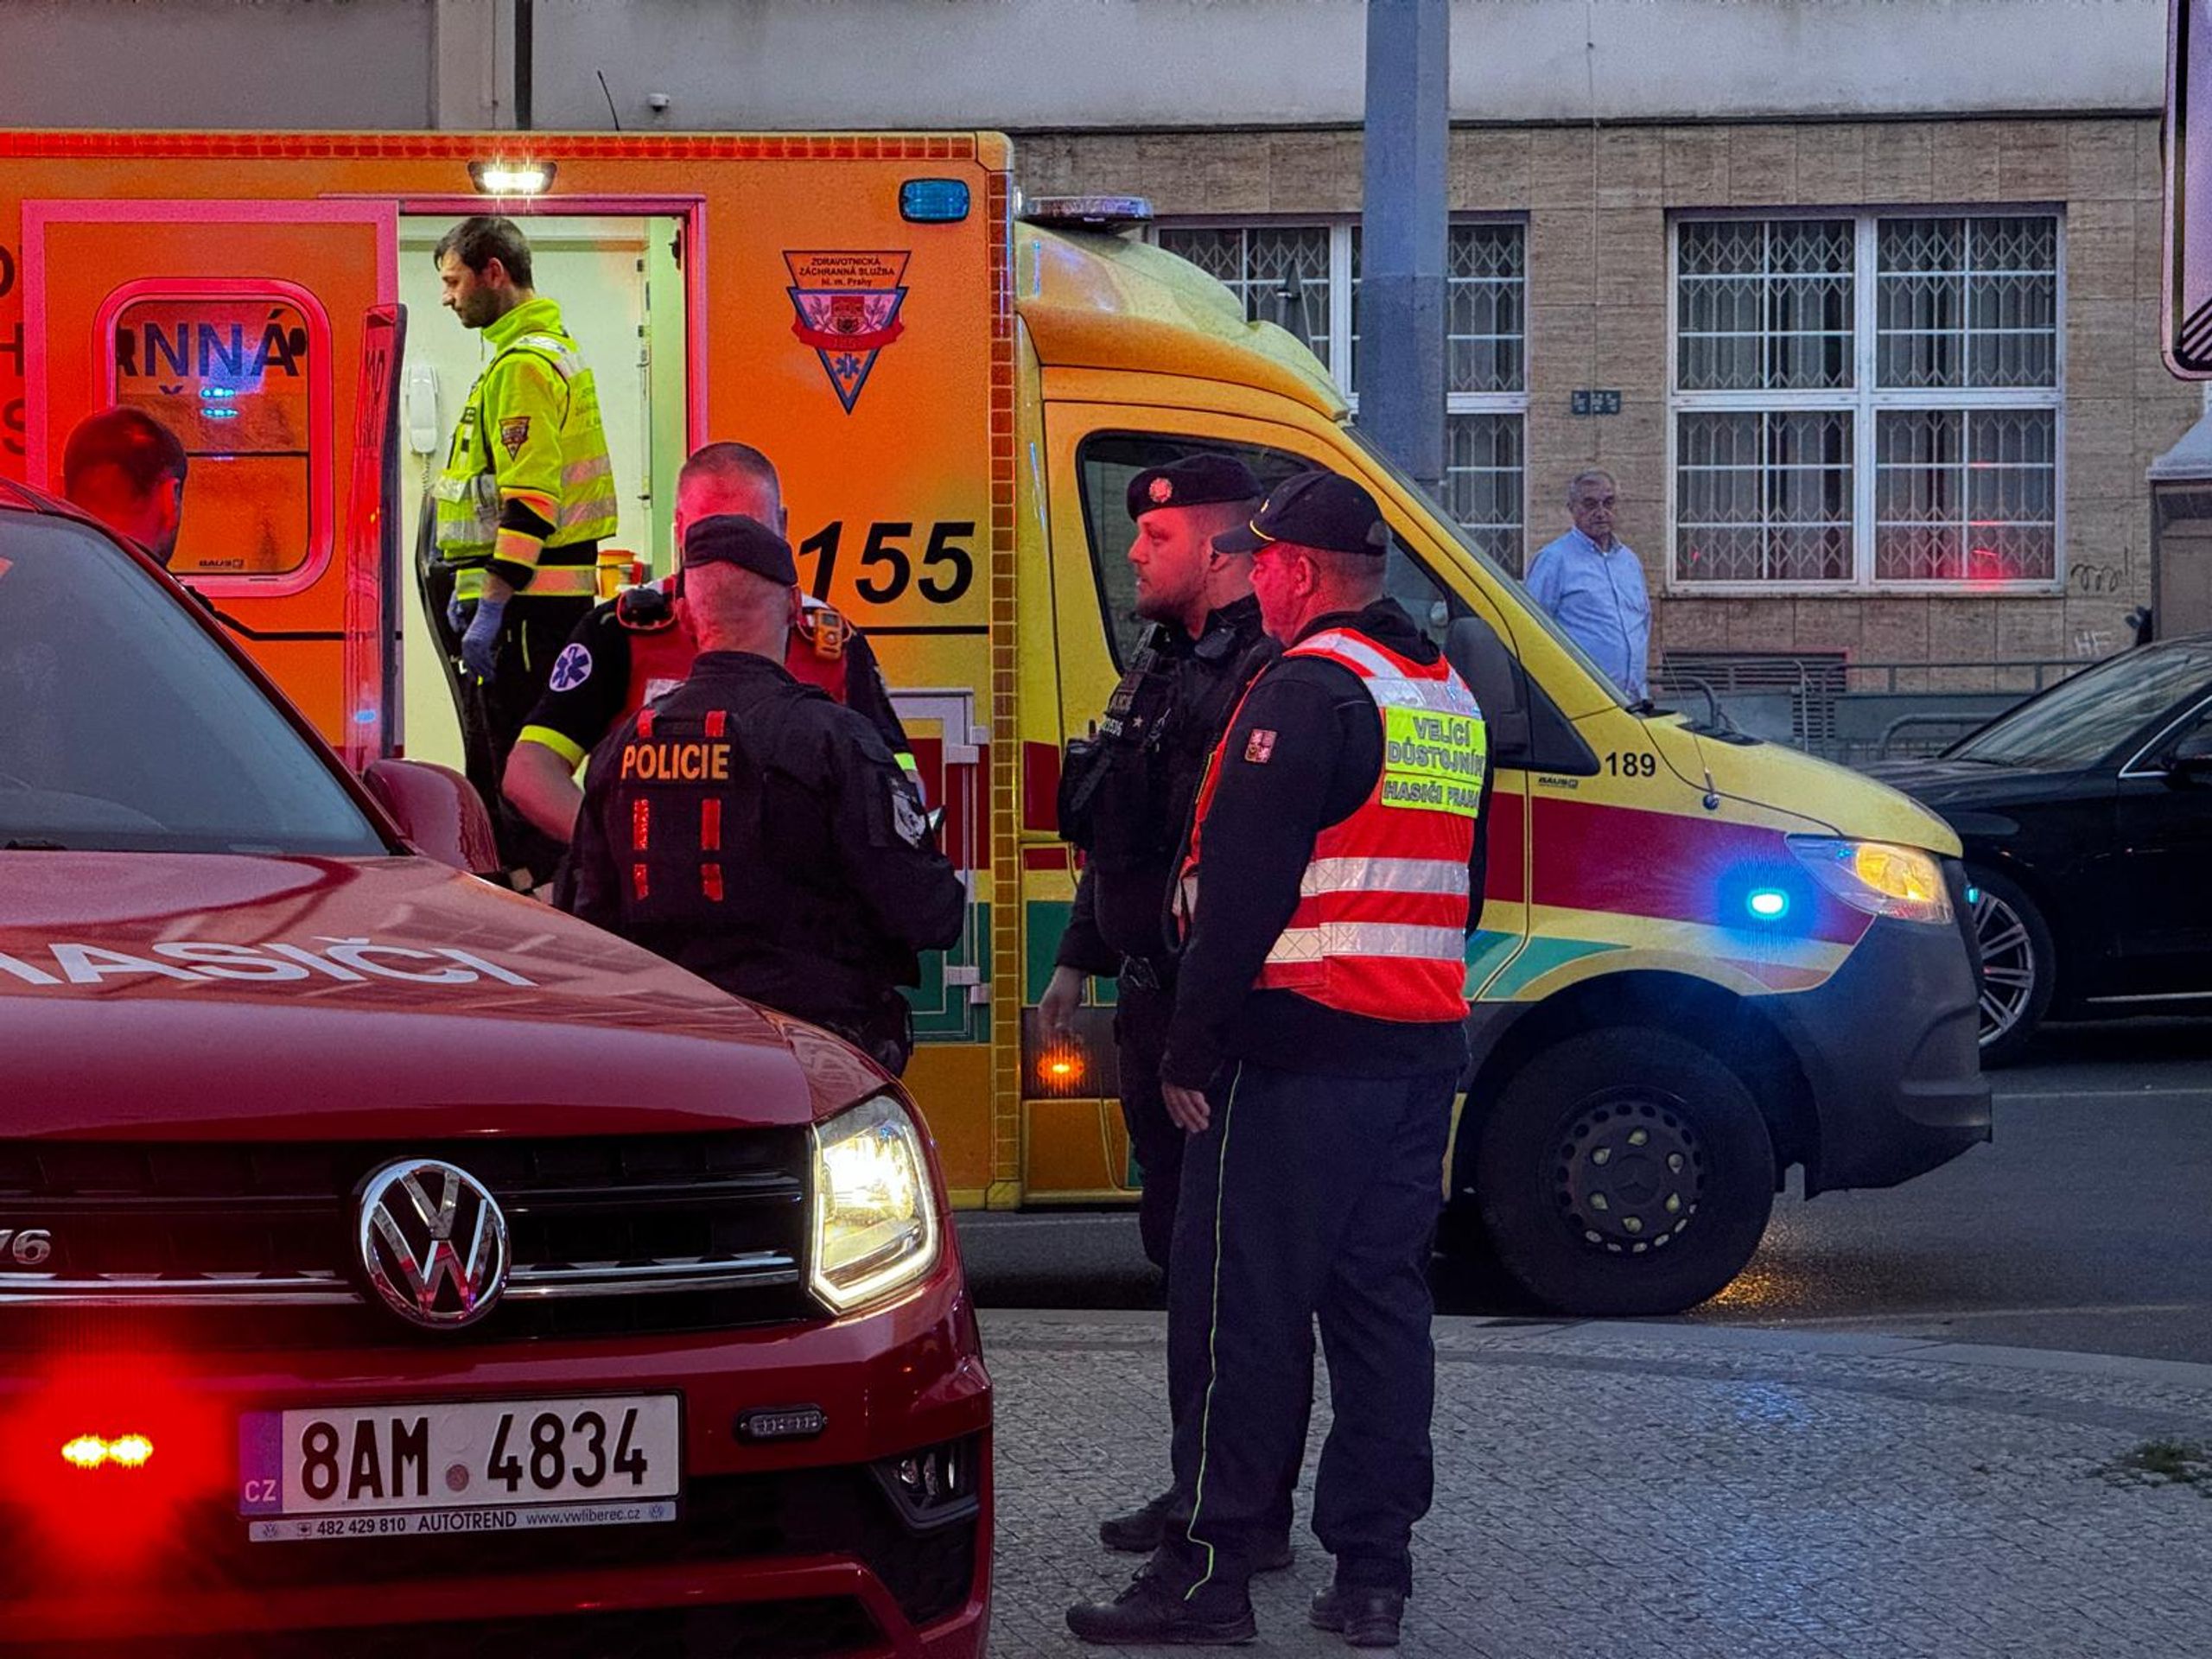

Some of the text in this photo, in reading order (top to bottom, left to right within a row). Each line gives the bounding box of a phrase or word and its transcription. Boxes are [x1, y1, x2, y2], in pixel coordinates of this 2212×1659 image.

[799, 521, 976, 604] 155
[621, 744, 730, 779] POLICIE
[1605, 752, 1656, 777] 189
[1384, 780, 1443, 804] HASIČI
[302, 1408, 648, 1500] 8AM 4834
[245, 1479, 276, 1503] CZ
[317, 1521, 344, 1535] 482
[348, 1519, 375, 1534] 429
[379, 1517, 406, 1532] 810
[417, 1510, 517, 1532] AUTOTREND
[526, 1507, 641, 1526] www.vwliberec.cz
